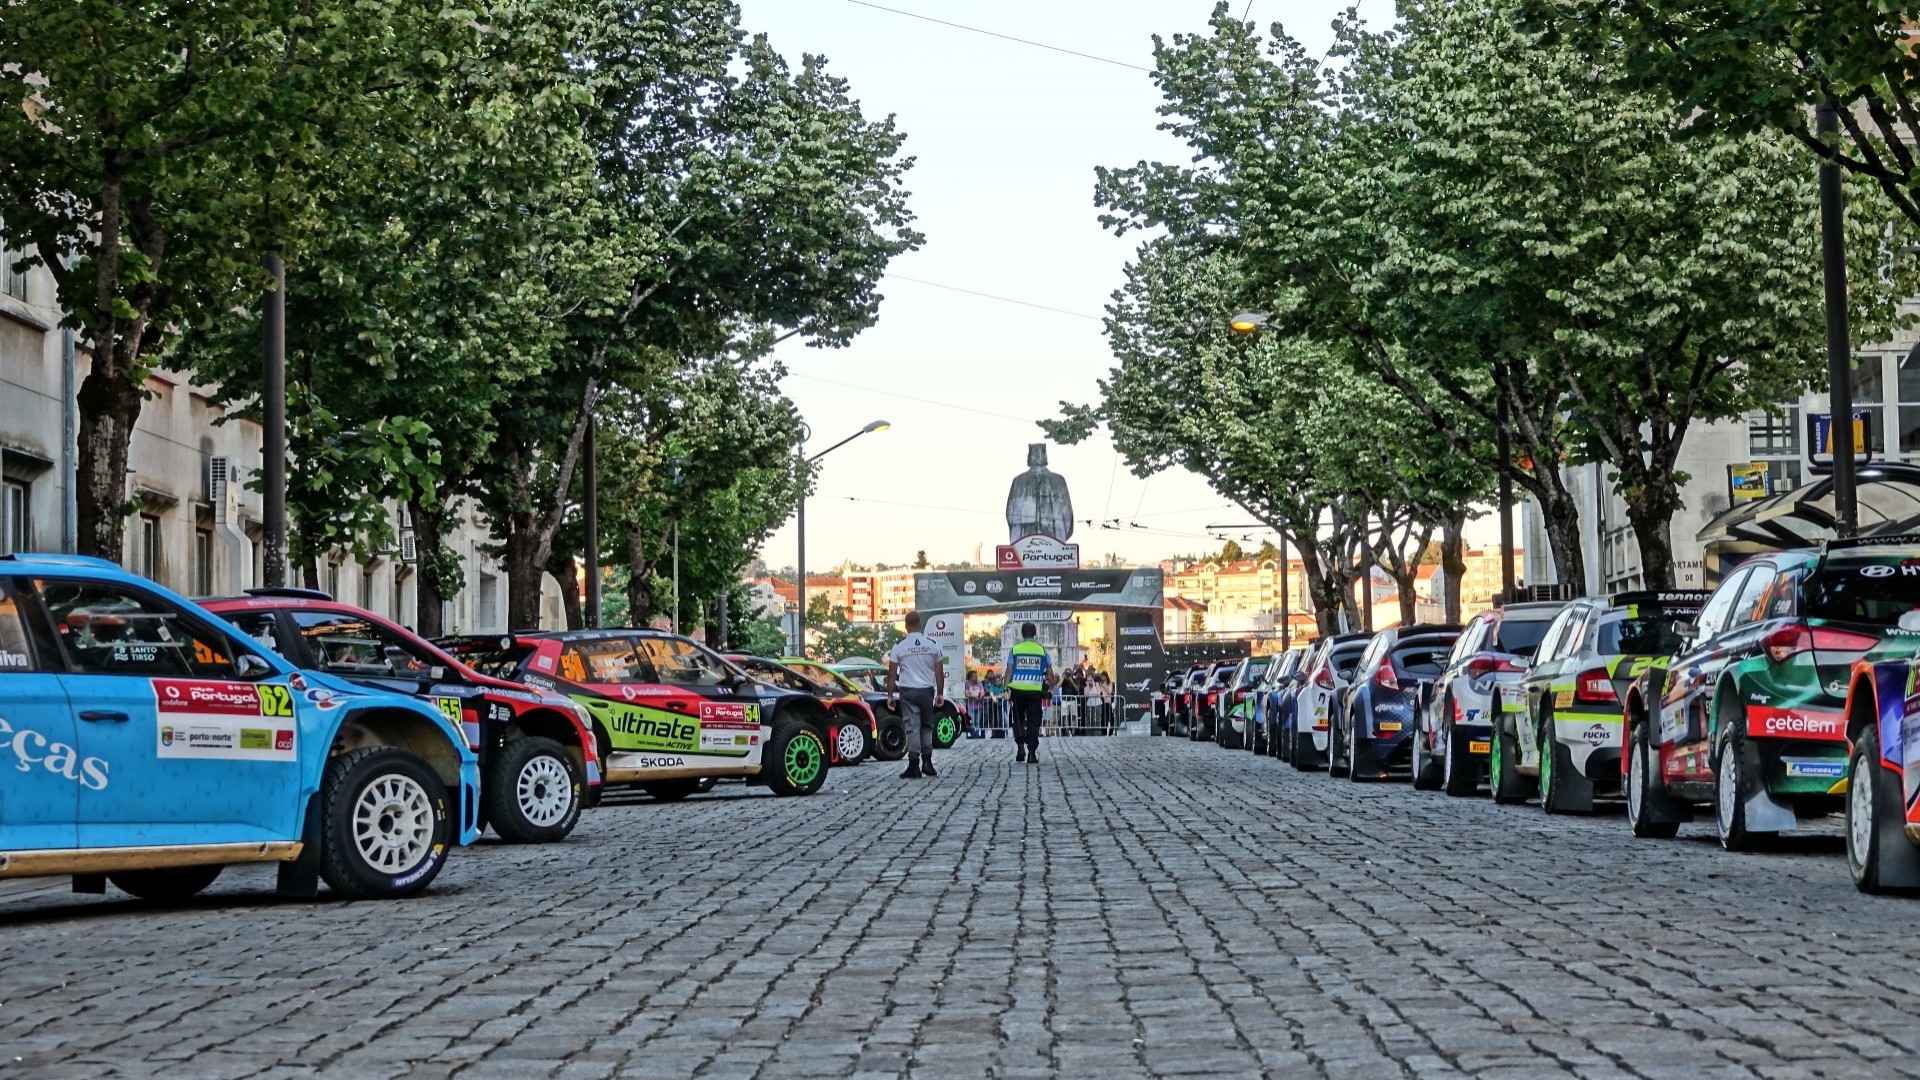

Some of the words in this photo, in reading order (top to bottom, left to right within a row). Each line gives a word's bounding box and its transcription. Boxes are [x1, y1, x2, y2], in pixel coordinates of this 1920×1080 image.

[1022, 553, 1075, 562] Portugal
[1017, 576, 1062, 586] WRC
[1685, 574, 1693, 582] DE
[131, 653, 155, 661] TIRSO
[1629, 656, 1671, 677] 24
[532, 676, 553, 688] Castrol
[191, 691, 258, 704] Portugal
[492, 688, 534, 700] HYUNDAI
[636, 687, 673, 696] vodafone
[258, 684, 292, 716] 62
[439, 698, 461, 723] 55
[746, 705, 759, 722] 54
[611, 712, 695, 741] ultimate
[1766, 715, 1836, 733] cetelem
[190, 733, 210, 742] porto
[212, 733, 232, 741] norte
[1583, 731, 1610, 739] FUCHS
[665, 741, 693, 750] ACTIVE
[640, 756, 685, 767] ŠKODA
[395, 858, 434, 886] MICHELIN
